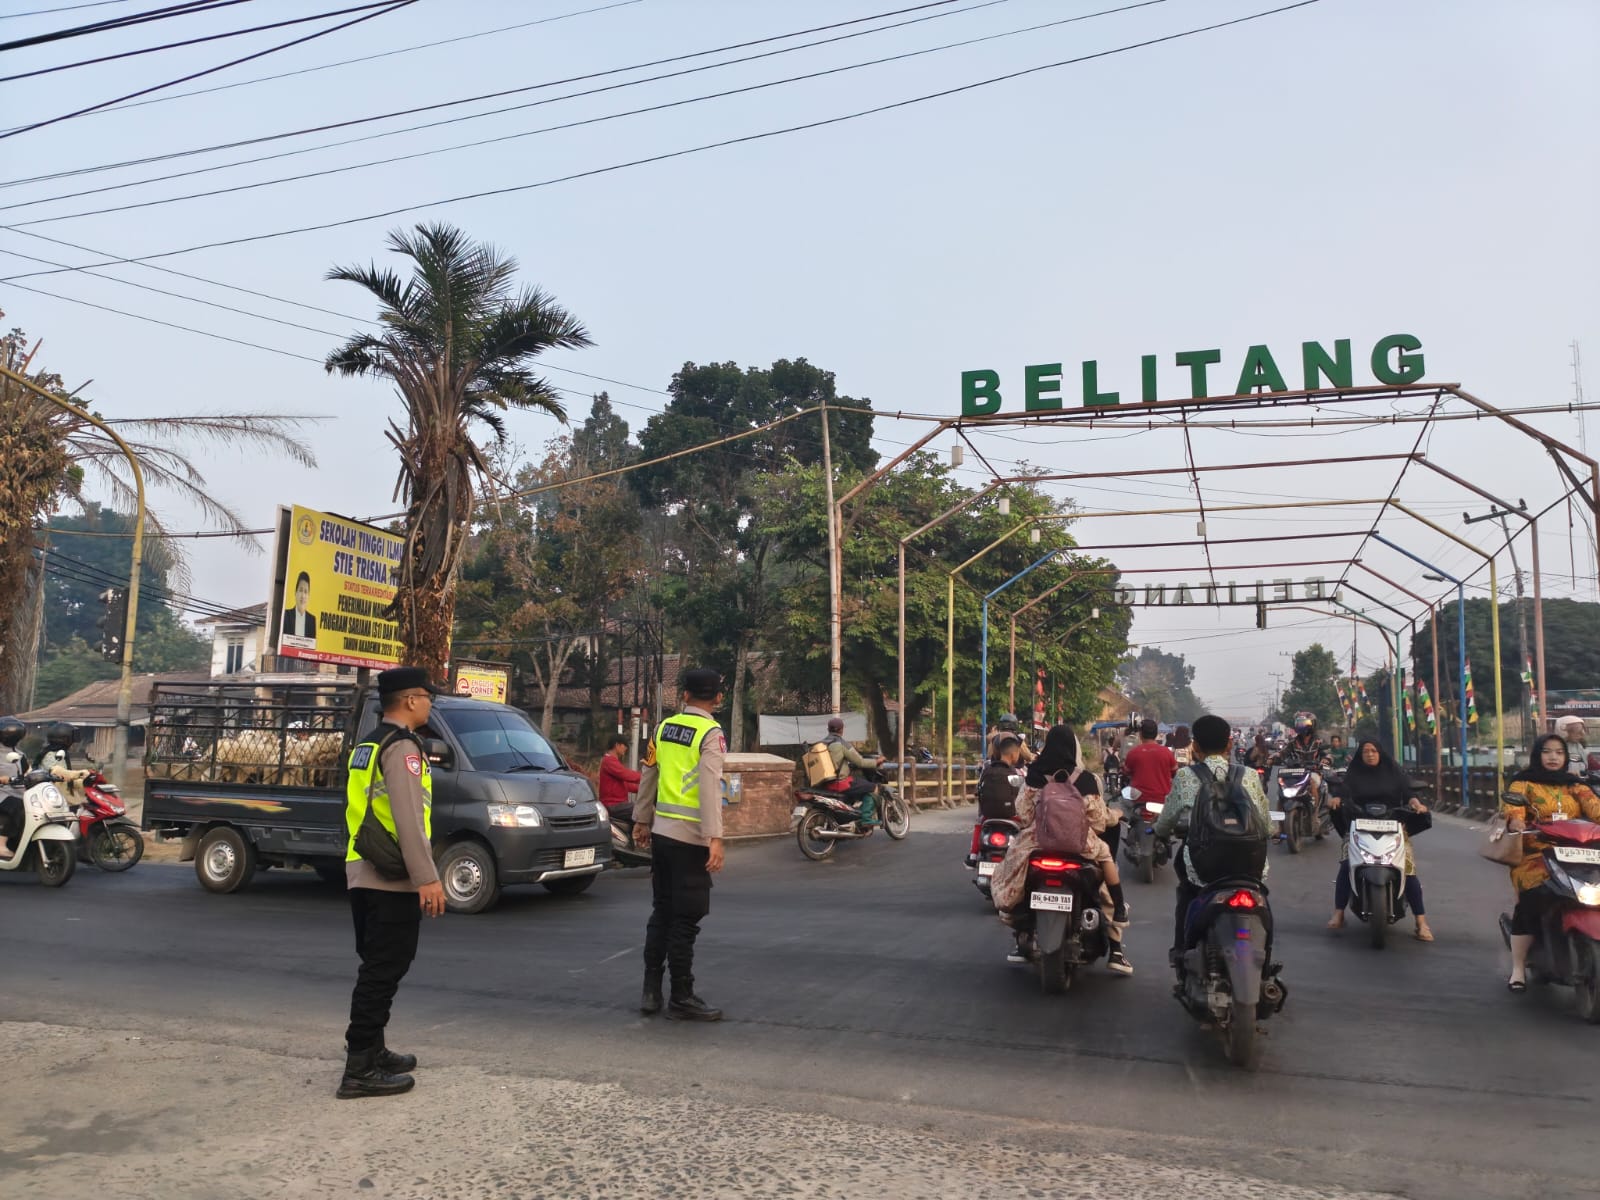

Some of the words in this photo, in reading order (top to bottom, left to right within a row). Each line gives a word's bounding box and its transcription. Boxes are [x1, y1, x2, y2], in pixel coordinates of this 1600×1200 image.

[961, 334, 1426, 416] BELITANG
[320, 520, 357, 550] SEKOLAH
[359, 531, 385, 558] TINGGI
[333, 551, 354, 576] STIE
[356, 557, 387, 585] TRISNA
[320, 611, 348, 633] PROGRAM
[471, 687, 494, 695] CORNER
[662, 724, 695, 743] POLISI
